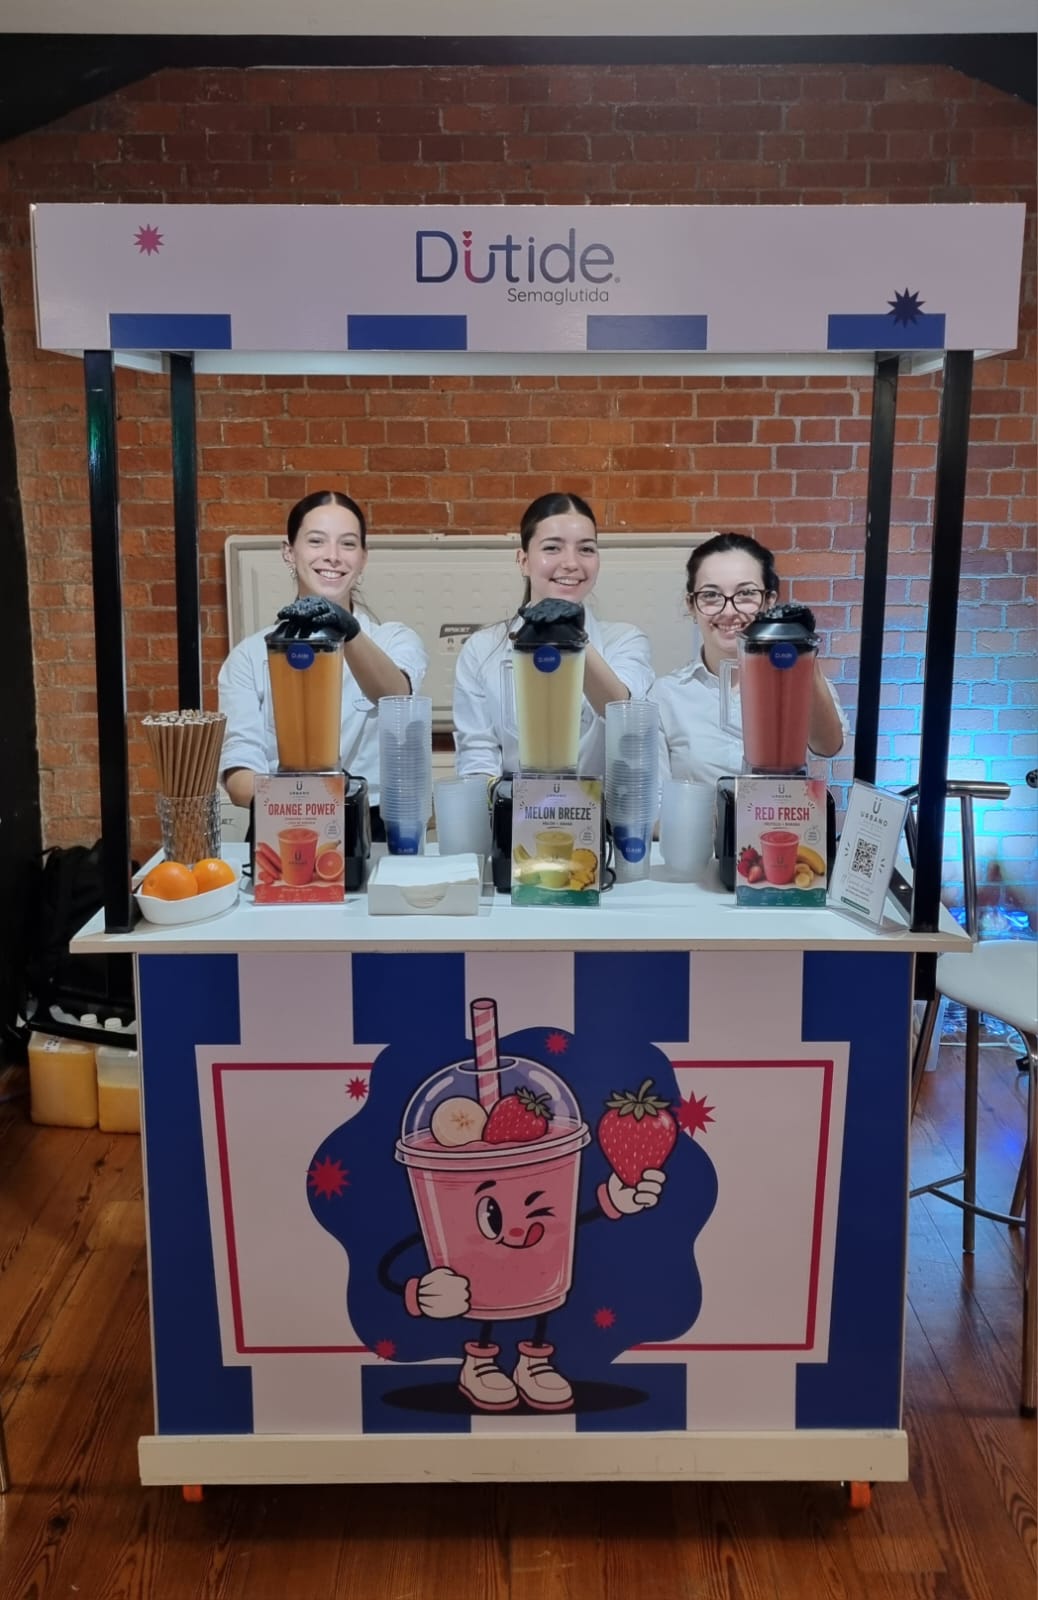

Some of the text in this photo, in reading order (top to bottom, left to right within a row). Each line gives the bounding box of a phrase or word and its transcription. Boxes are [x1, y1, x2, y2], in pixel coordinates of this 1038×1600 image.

[507, 288, 609, 305] Semaglutida
[268, 803, 336, 816] ORANGE POWER
[525, 806, 592, 820] MELON BREEZE
[755, 807, 810, 821] RED FRESH
[860, 810, 888, 827] URBANO
